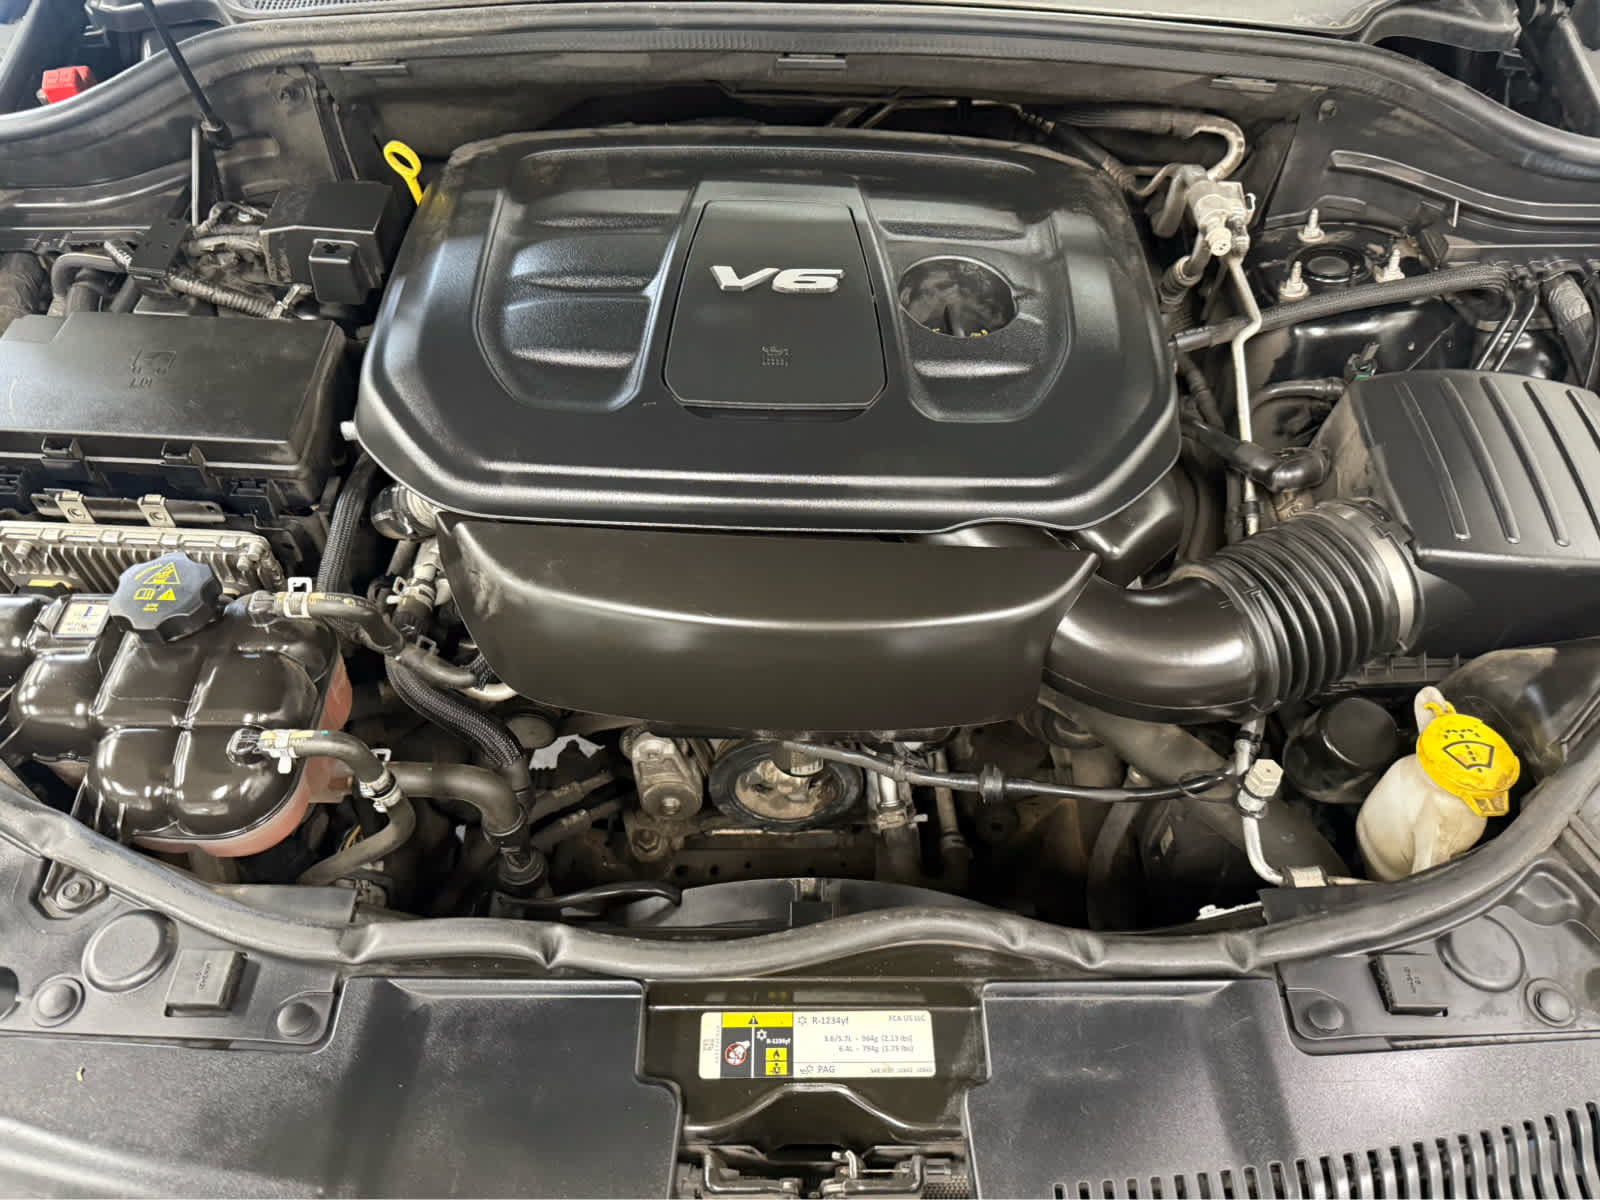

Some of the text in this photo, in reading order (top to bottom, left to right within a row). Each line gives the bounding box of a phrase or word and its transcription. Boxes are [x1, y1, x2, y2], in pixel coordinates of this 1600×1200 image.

[709, 265, 845, 293] V6
[812, 1015, 849, 1026] R-1234yf
[888, 1014, 926, 1022] FCA US LLC
[817, 1065, 836, 1073] PAG
